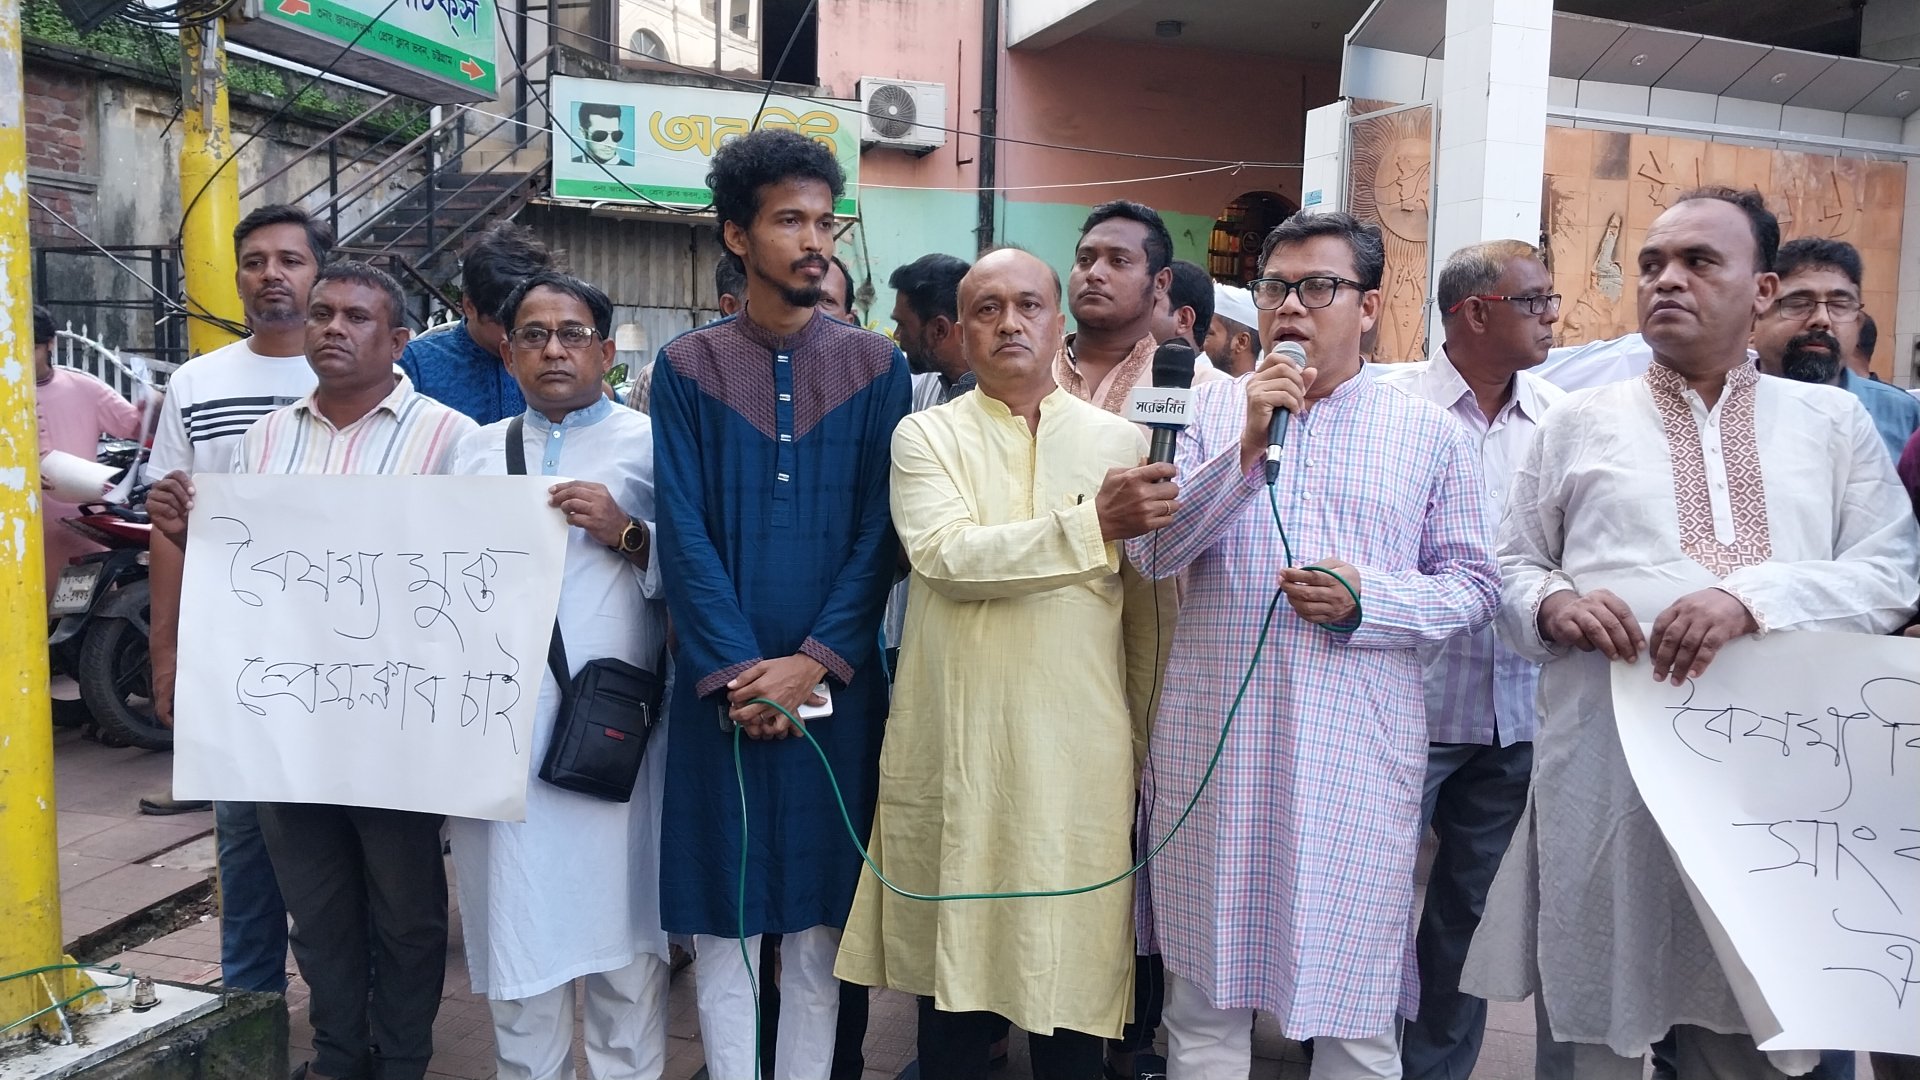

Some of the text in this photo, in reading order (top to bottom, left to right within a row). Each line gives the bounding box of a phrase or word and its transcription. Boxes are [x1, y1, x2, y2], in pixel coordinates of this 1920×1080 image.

[1136, 397, 1186, 415] সরেজমিন
[210, 516, 530, 652] বৈষম্য মুক্ত
[460, 632, 521, 755] চাই
